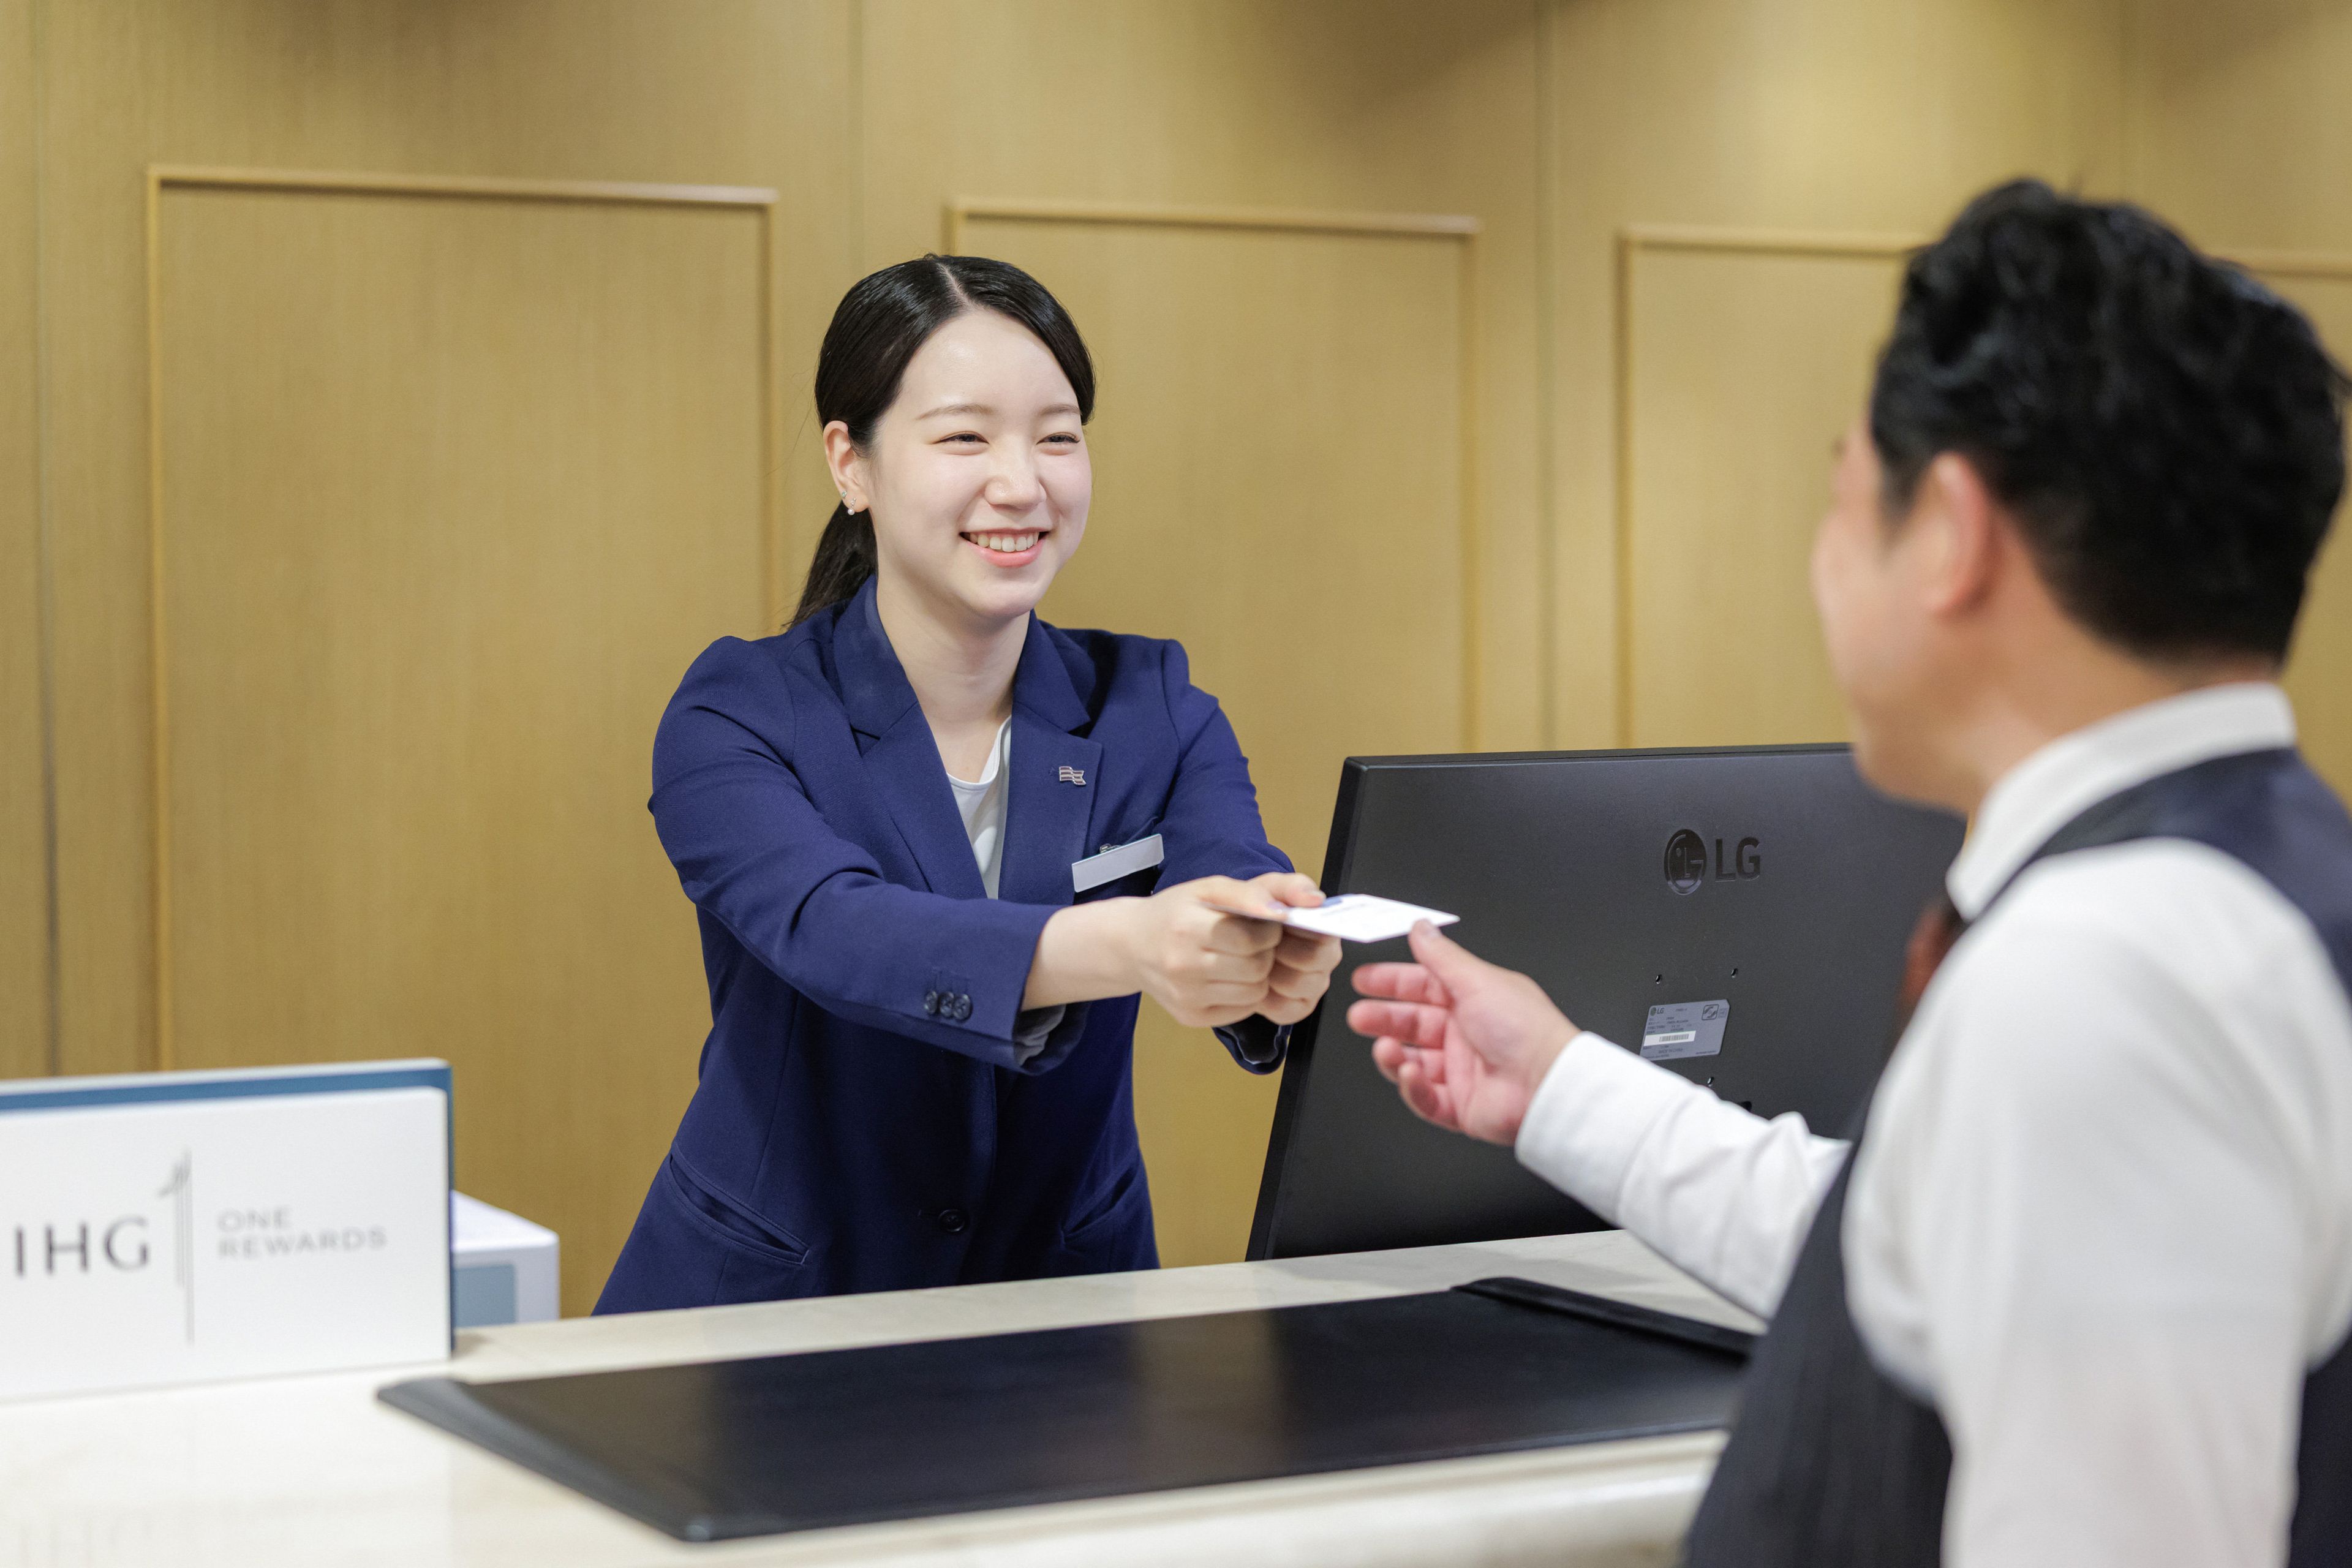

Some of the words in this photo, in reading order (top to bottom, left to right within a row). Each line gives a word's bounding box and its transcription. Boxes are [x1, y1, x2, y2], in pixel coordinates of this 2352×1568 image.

[1716, 837, 1761, 881] LG
[217, 1206, 292, 1233] ONE
[14, 1215, 150, 1278] IHG
[217, 1226, 388, 1259] REWARDS
